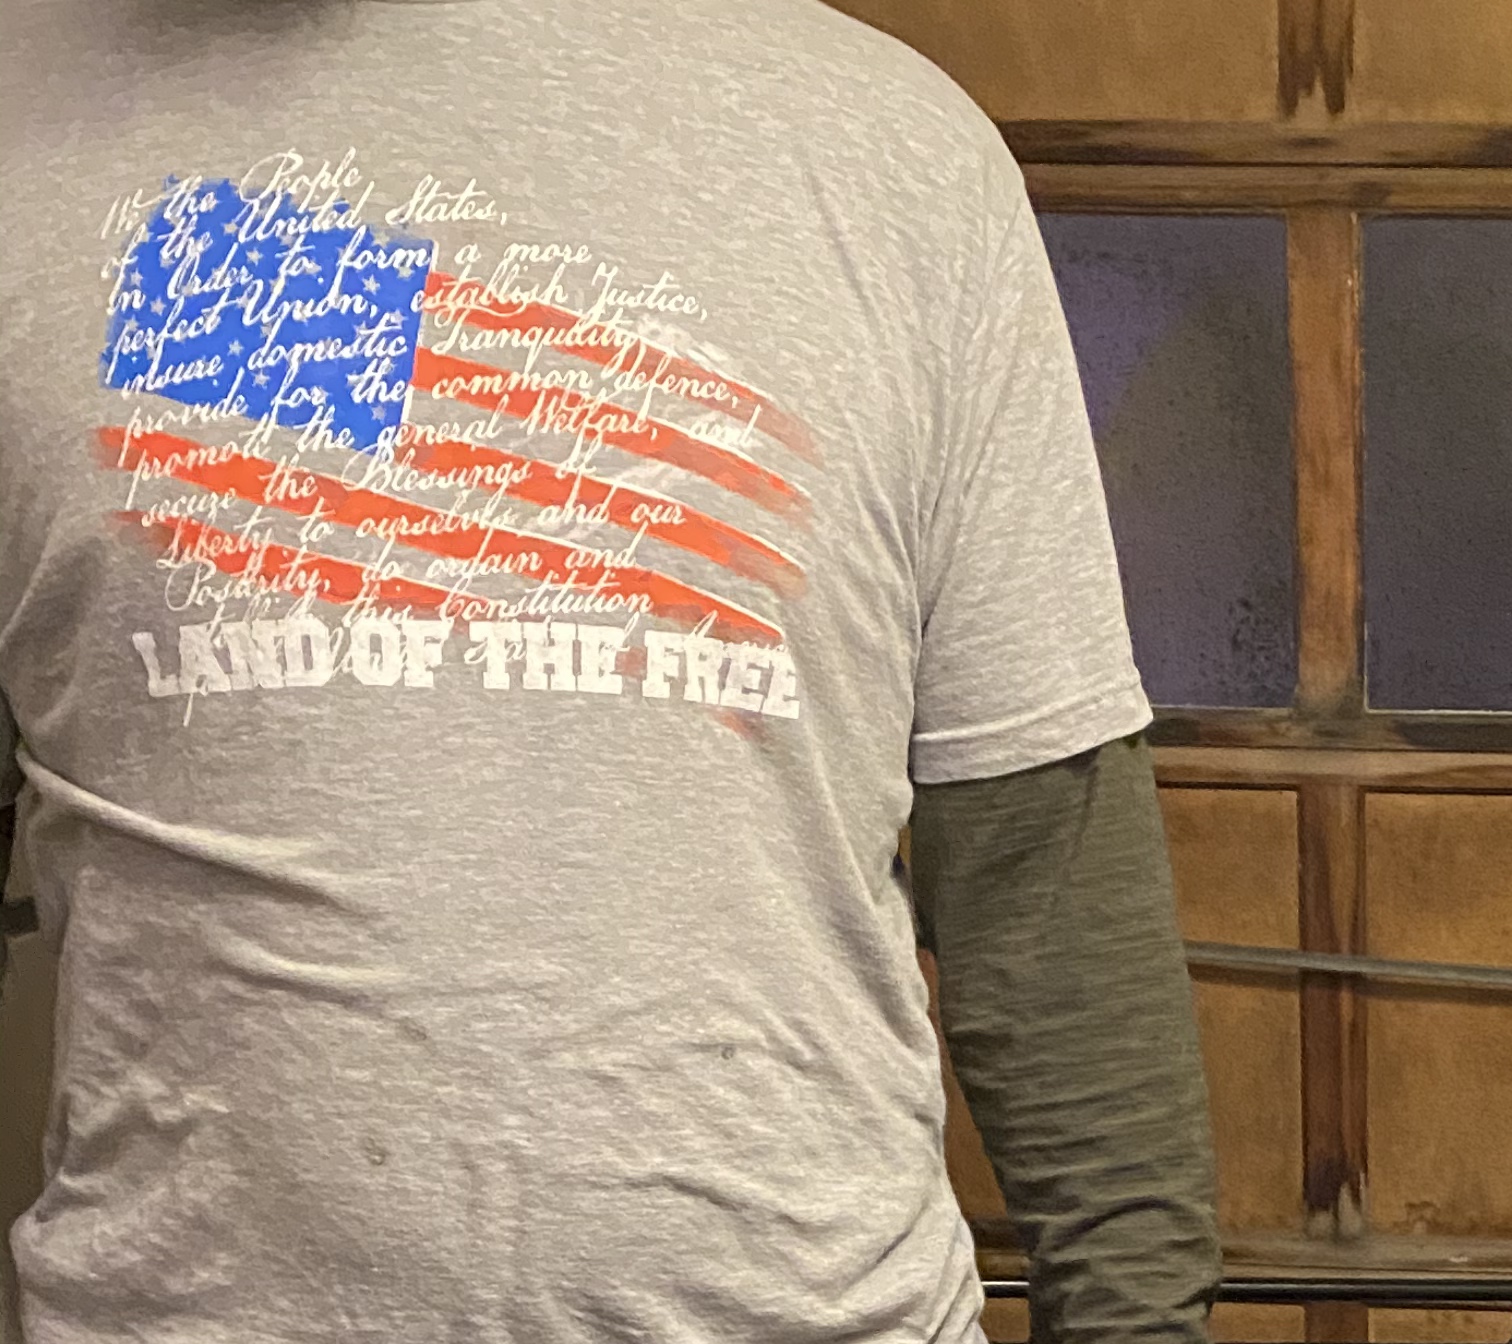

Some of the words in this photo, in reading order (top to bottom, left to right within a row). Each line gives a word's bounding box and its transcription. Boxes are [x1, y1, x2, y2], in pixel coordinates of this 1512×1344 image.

[163, 173, 216, 218] the
[238, 146, 362, 214] People
[100, 222, 140, 306] of
[157, 213, 214, 258] the
[231, 180, 375, 243] United
[385, 173, 507, 226] States,
[167, 242, 254, 301] Order
[275, 235, 315, 276] to
[331, 224, 432, 303] form
[454, 242, 482, 265] a
[503, 242, 592, 268] more
[105, 288, 244, 390] perfect
[241, 278, 378, 328] Union,
[410, 263, 569, 316] establish
[591, 262, 708, 320] Justice,
[247, 307, 408, 372] domestic
[118, 367, 250, 468] provide
[264, 364, 329, 442] for
[347, 356, 406, 404] the
[431, 366, 593, 400] common
[613, 342, 739, 420] defence,
[127, 412, 270, 510] promote
[294, 404, 354, 453] the
[376, 394, 509, 462] general
[519, 387, 659, 462] Welfare,
[687, 403, 764, 448] and
[141, 487, 237, 527] secure
[258, 454, 319, 504] the
[341, 443, 533, 520] Blessings
[554, 432, 602, 505] of
[156, 504, 276, 578] Liberty
[295, 497, 336, 543] to
[355, 487, 517, 540] ourselves
[536, 484, 619, 526] and
[629, 502, 688, 526] our
[361, 533, 404, 583] do
[424, 525, 543, 583] ordain
[564, 520, 649, 570] and
[438, 570, 655, 624] Constitution
[132, 613, 332, 697] LAND
[350, 617, 454, 688] OF
[468, 620, 624, 695] THE
[641, 628, 800, 720] FREE
